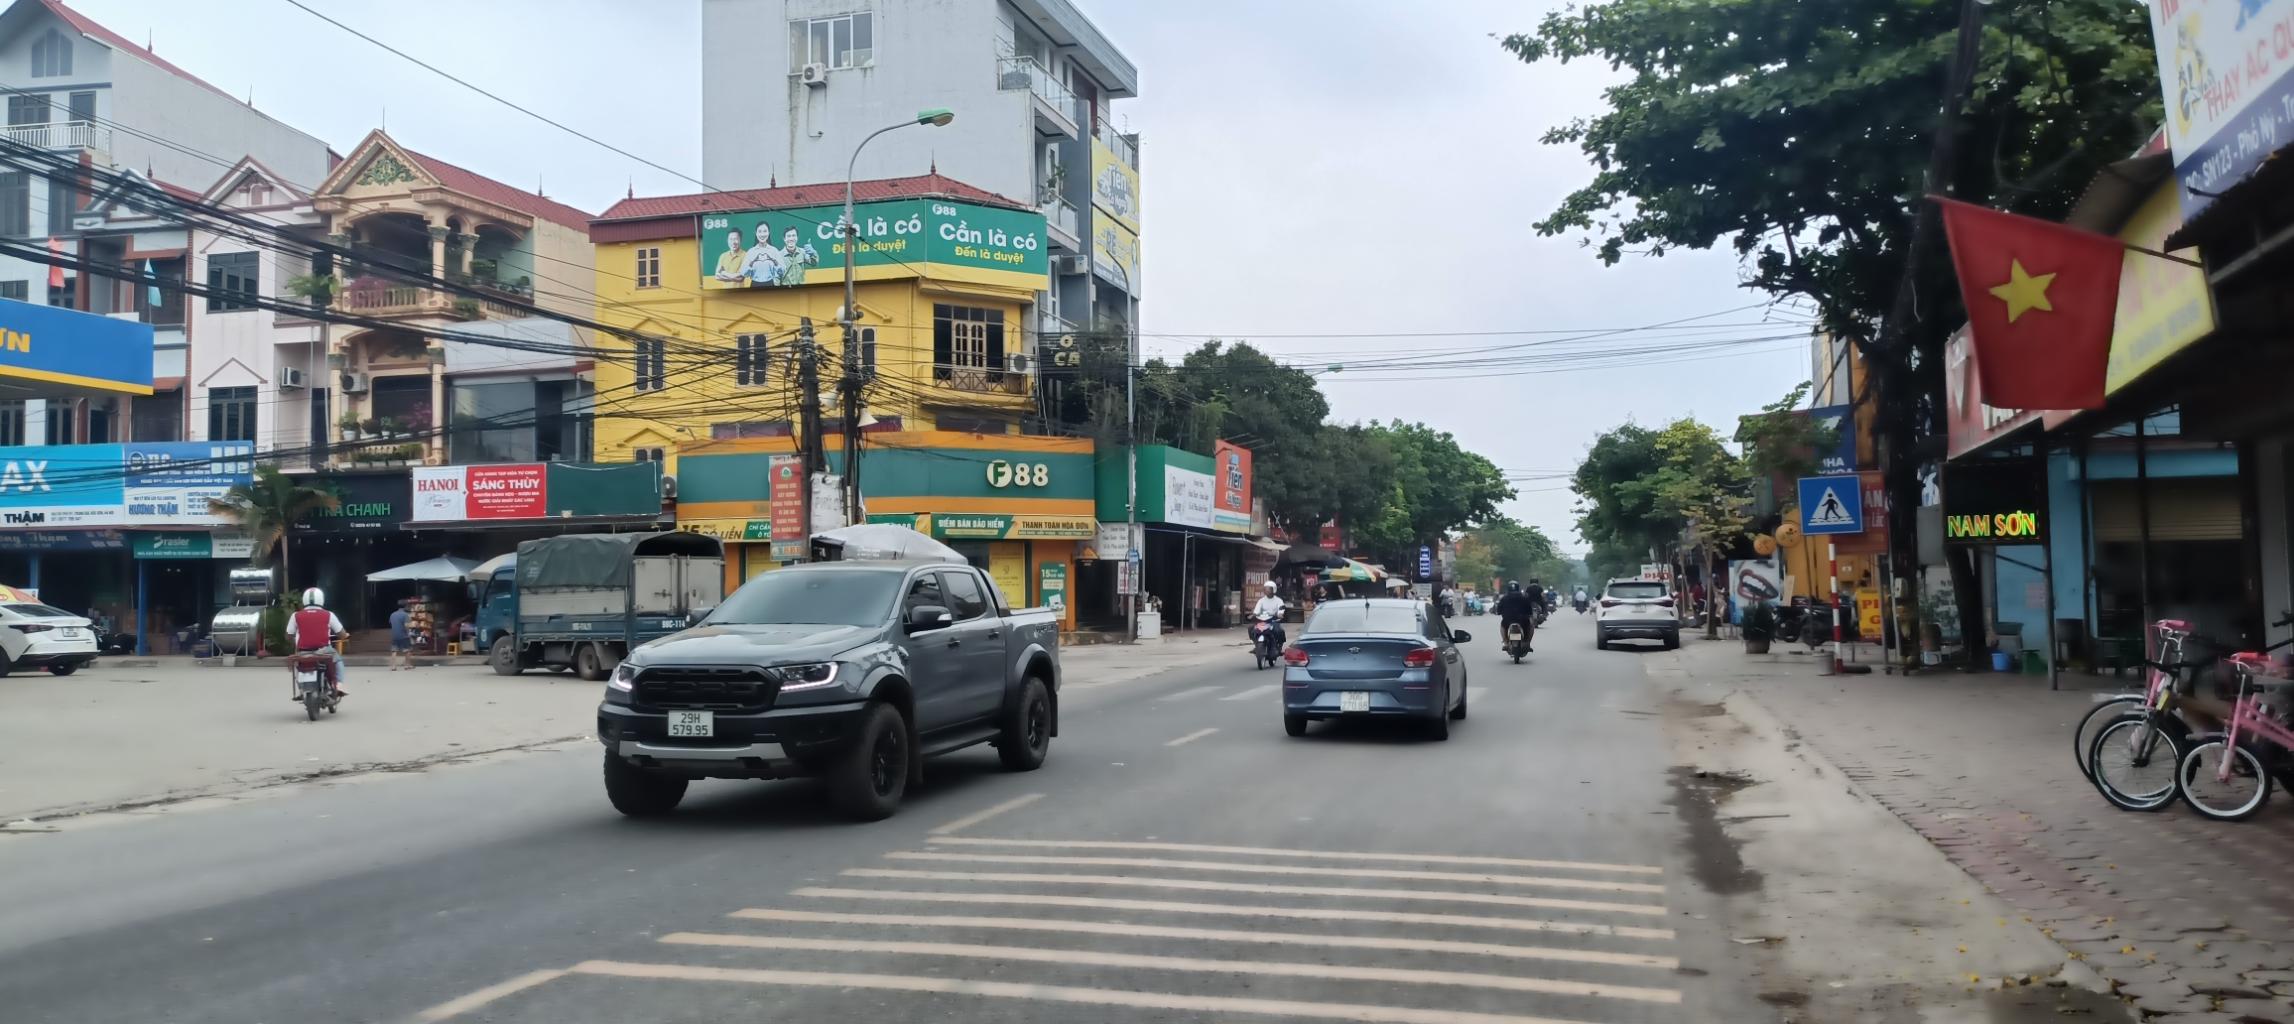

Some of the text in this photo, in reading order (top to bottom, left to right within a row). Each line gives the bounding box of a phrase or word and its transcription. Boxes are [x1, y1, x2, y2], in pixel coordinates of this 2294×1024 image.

[867, 217, 887, 237] là
[894, 213, 922, 234] có
[940, 220, 1038, 251] Cần là có
[873, 239, 906, 251] duyệt
[955, 246, 1024, 264] Đến là duyệt
[987, 459, 1049, 488] F88
[418, 479, 459, 491] HANOI
[473, 476, 540, 490] SÁNG THÙY
[346, 503, 391, 516] CHANH
[4, 510, 45, 527] THẬM
[1947, 509, 2035, 538] NAM SƠN
[1245, 571, 1269, 585] PHOTO
[681, 712, 701, 724] 29H
[672, 724, 708, 736] 579.95
